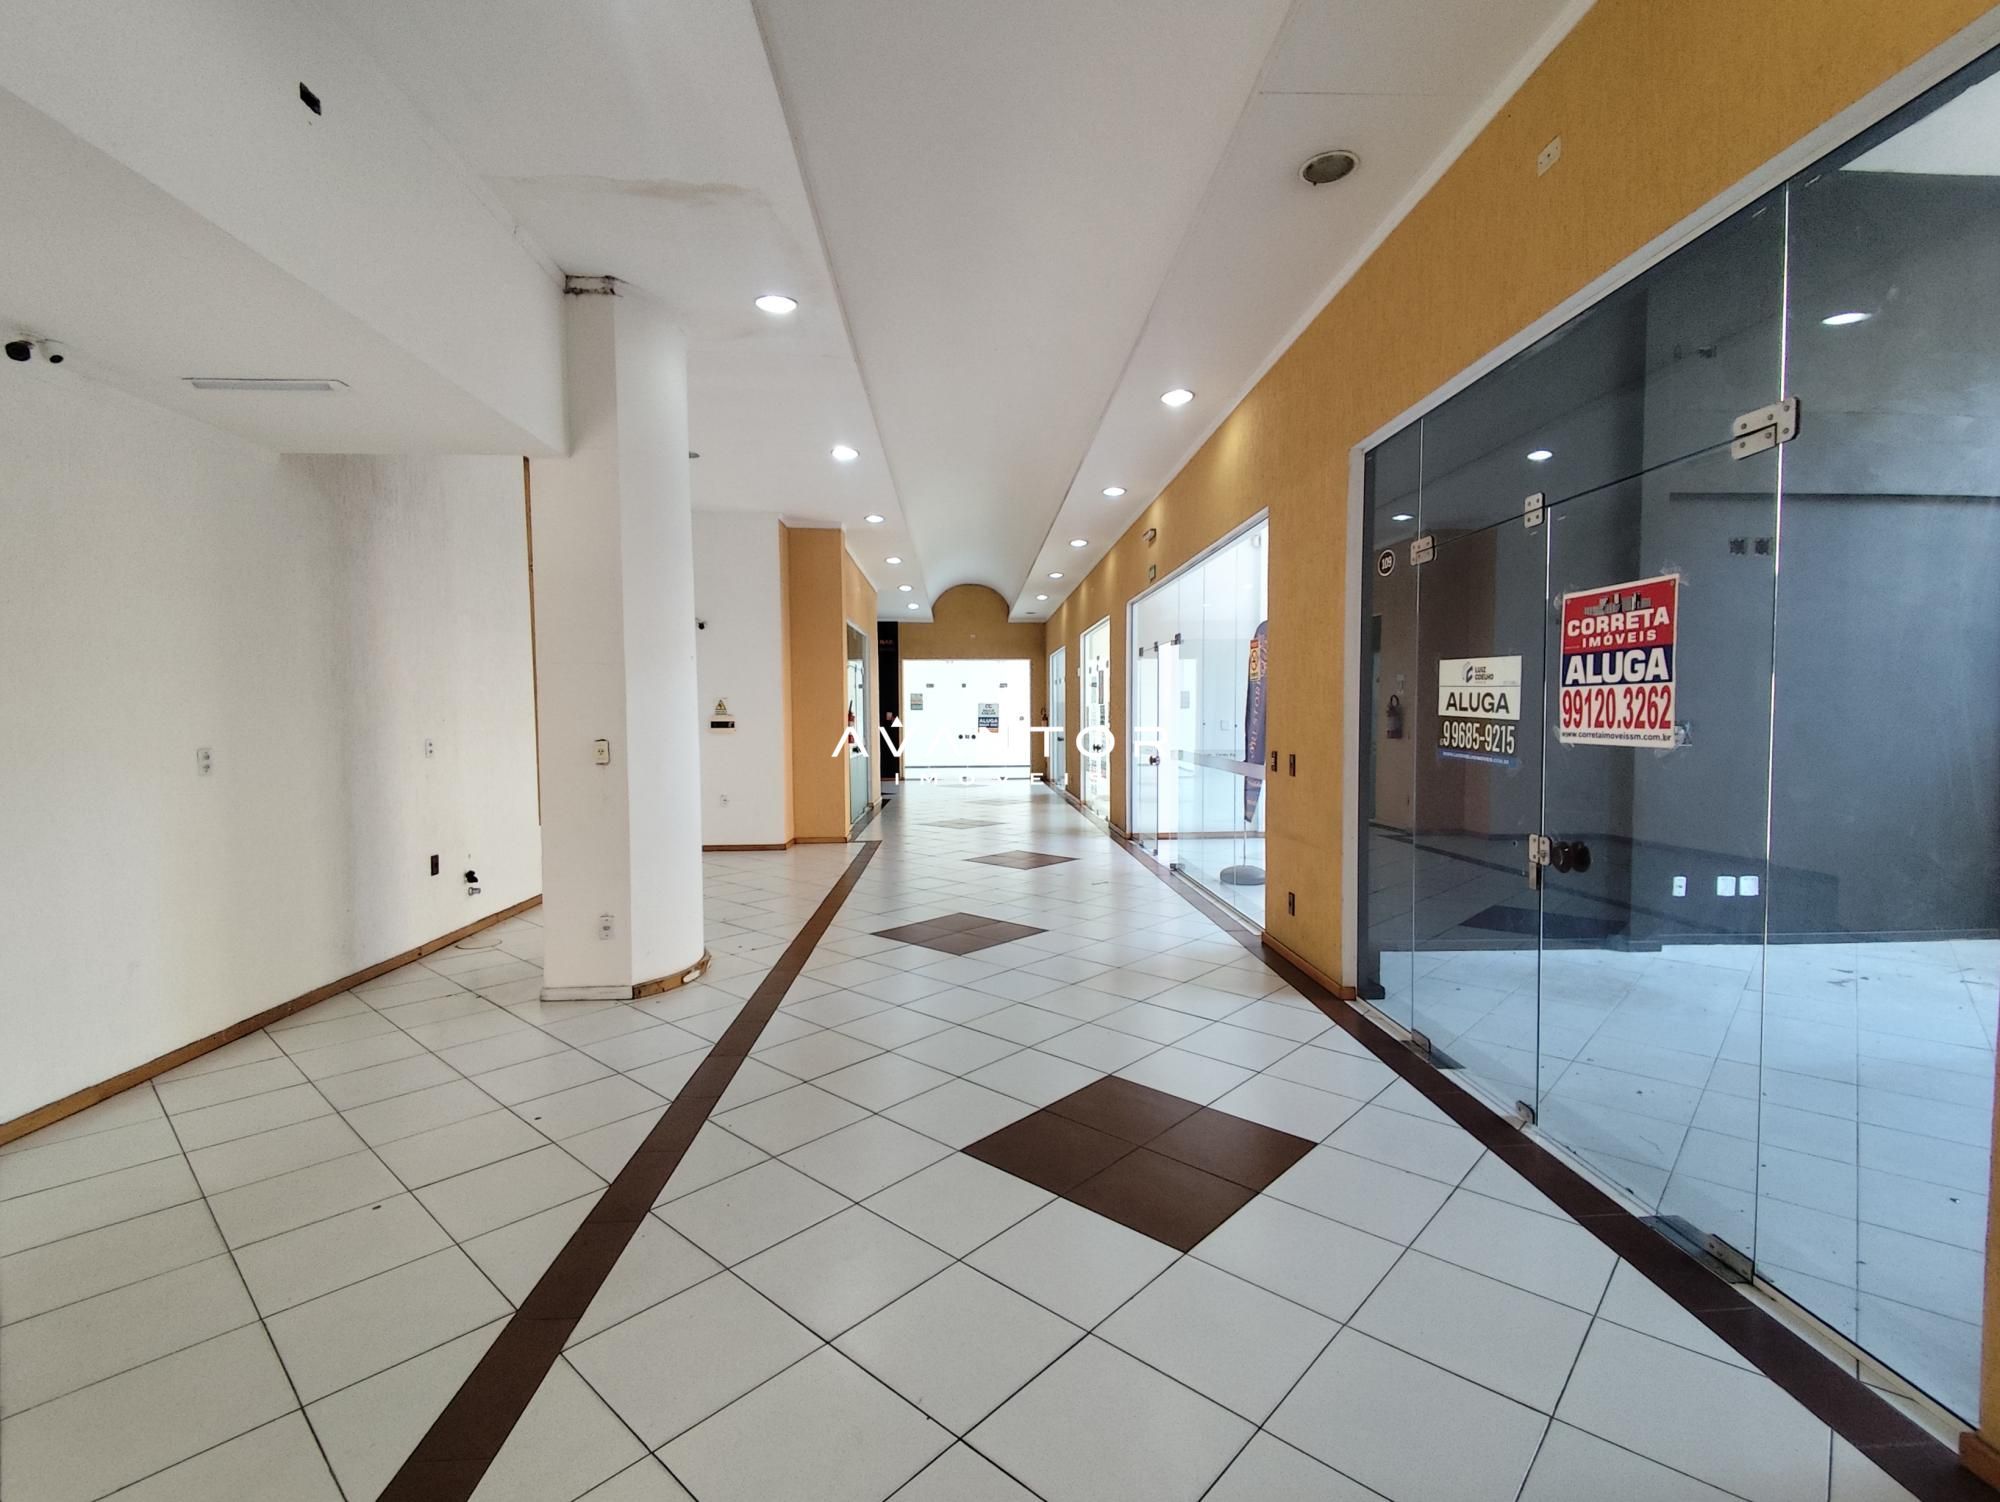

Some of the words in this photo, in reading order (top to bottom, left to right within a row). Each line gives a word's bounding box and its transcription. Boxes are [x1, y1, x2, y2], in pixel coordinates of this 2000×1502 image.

[1567, 606, 1670, 638] CORRETA
[1582, 629, 1657, 649] IMÓVEIS
[1564, 647, 1669, 686] ALUGA
[1445, 692, 1510, 715] ALUGA
[1562, 685, 1672, 730] 99120.3262
